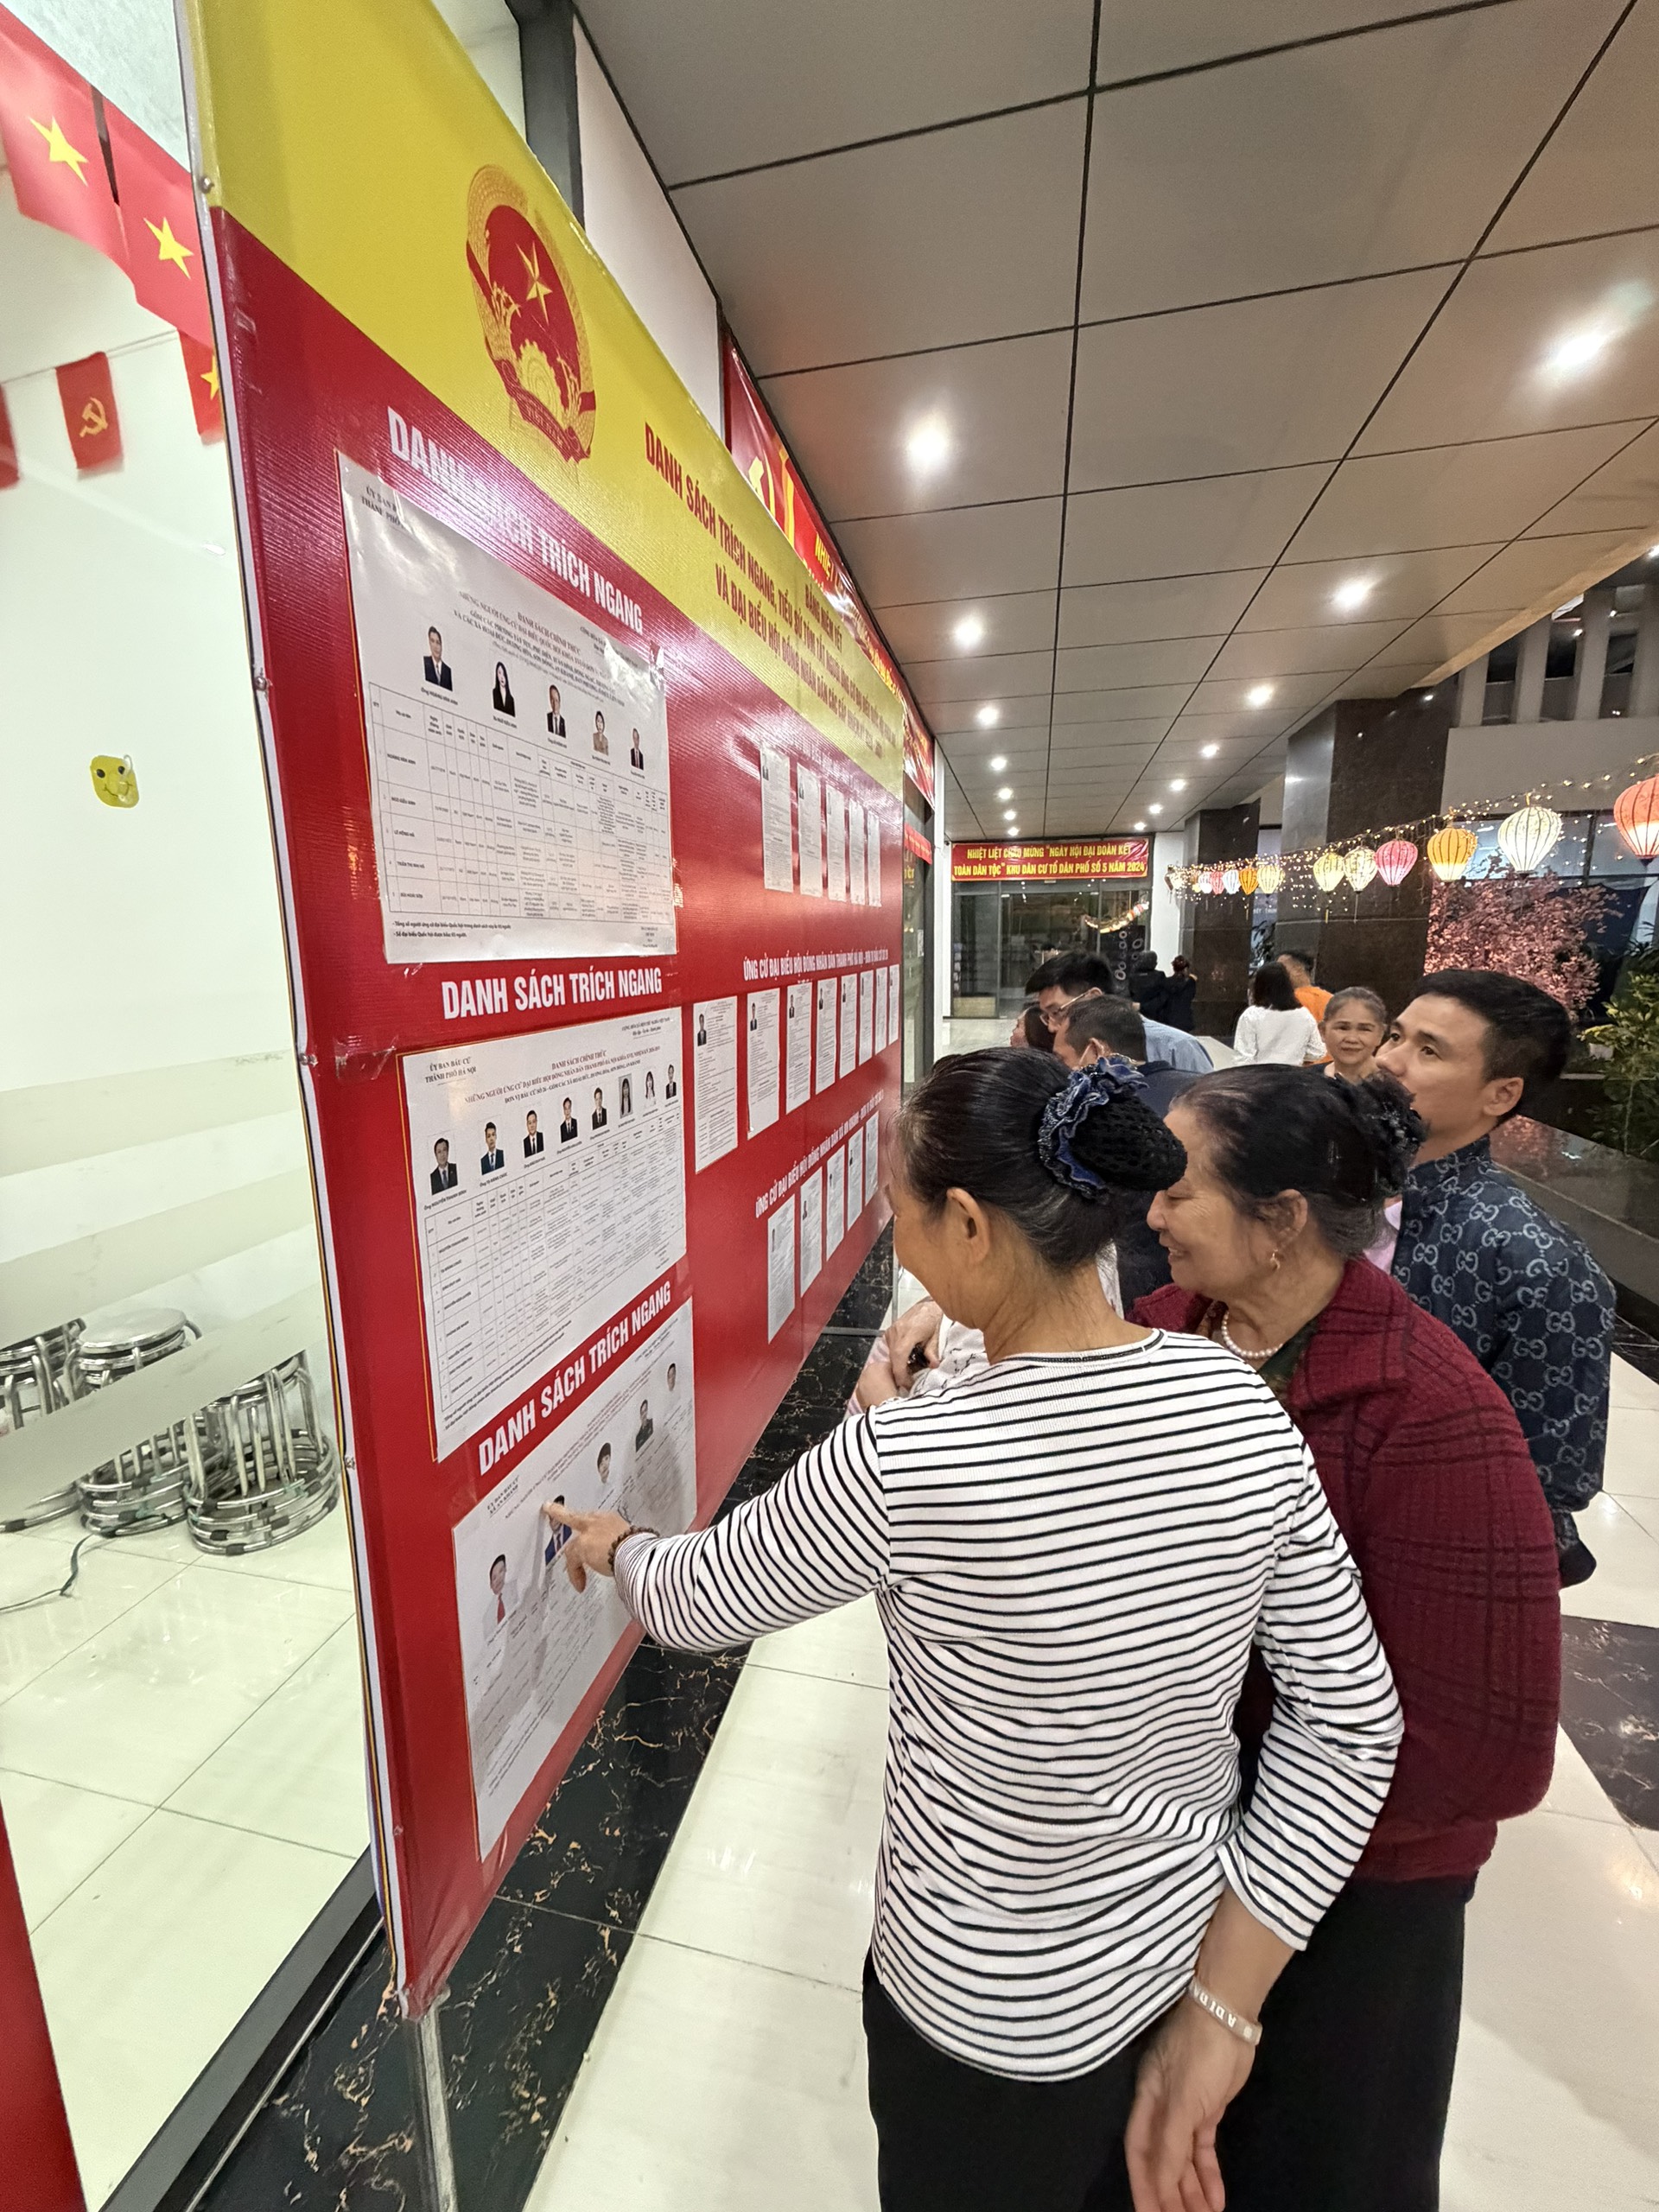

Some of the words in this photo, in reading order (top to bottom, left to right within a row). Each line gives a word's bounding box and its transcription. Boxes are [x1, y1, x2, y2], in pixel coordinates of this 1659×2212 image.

[645, 422, 682, 502] DANH
[685, 472, 715, 541] SÁCH
[718, 513, 745, 575] TRÍCH
[747, 549, 776, 614] NGANG,
[779, 588, 791, 628] TIỂU
[538, 524, 590, 598] TRÍCH
[594, 570, 643, 634] NGANG
[715, 561, 728, 606] VÀ
[731, 578, 746, 628] ĐẠI
[748, 600, 766, 643] BIỂU
[517, 611, 533, 628] DANH
[534, 621, 549, 638] SÁCH
[954, 863, 972, 876] TOÀN
[972, 863, 988, 876] DÂN
[1006, 864, 1020, 875] KHU
[1021, 862, 1037, 875] DÂN
[1038, 862, 1049, 874] CƯ
[1058, 861, 1073, 874] DÂN
[1075, 859, 1090, 873] PHỐ
[1091, 859, 1102, 873] SỐ
[1102, 863, 1108, 873] 5
[1109, 861, 1126, 873] NĂM
[1127, 861, 1145, 873] 2024
[967, 847, 987, 861] NHIỆT
[988, 846, 1002, 860] LIỆT
[1023, 846, 1045, 858] MỪNG
[1070, 844, 1082, 858] HỘI
[1083, 845, 1095, 858] ĐẠI
[1096, 843, 1116, 856] ĐOÀN
[1118, 843, 1131, 855] KẾT
[743, 956, 759, 981] ỨNG
[759, 952, 769, 979] CỬ
[769, 957, 780, 981] ĐẠI
[780, 950, 793, 976] BIỂU
[442, 978, 508, 1020] DANH
[514, 968, 565, 1011] SÁCH
[569, 965, 615, 1004] TRÍCH
[619, 967, 662, 998] NGANG
[424, 1071, 444, 1084] THÀNH
[438, 1061, 449, 1070] BAN
[551, 1060, 566, 1070] DANH
[566, 1056, 579, 1065] SÁCH
[755, 1192, 769, 1218] ỨNG
[769, 1179, 778, 1205] CỬ
[478, 1398, 537, 1476] DANH
[541, 1356, 586, 1418] SÁCH
[588, 1328, 629, 1374] TRÍCH
[631, 1281, 671, 1336] NGANG
